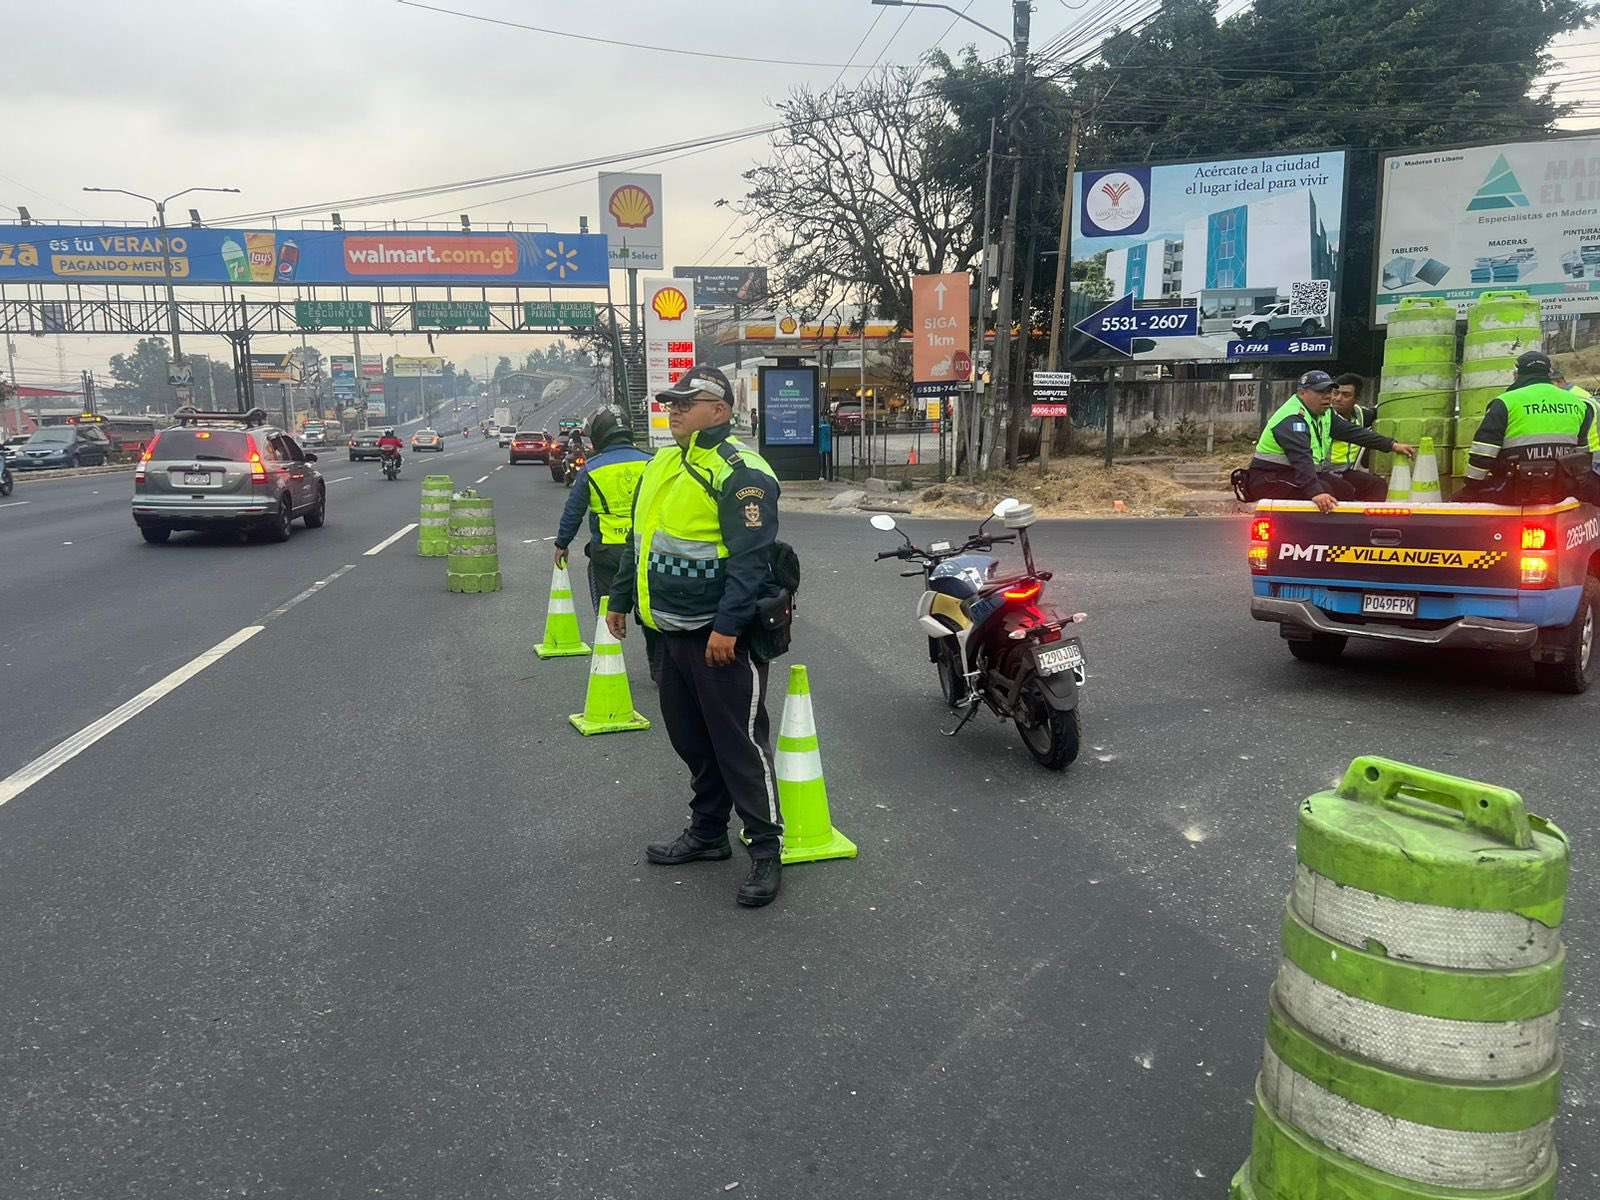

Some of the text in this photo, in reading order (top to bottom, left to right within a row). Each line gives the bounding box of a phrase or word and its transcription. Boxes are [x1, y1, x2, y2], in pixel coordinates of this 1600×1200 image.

[1195, 156, 1320, 178] Acércate a la ciudad
[1185, 174, 1329, 197] el lugar ideal para vivir
[1478, 213, 1543, 225] Especialistas
[1561, 208, 1598, 217] Madera
[49, 237, 187, 253] es tu VERANO
[1488, 238, 1528, 247] MADERAS
[349, 244, 513, 268] walmart.com.gt
[632, 251, 657, 260] Select
[1391, 246, 1429, 255] TABLEROS
[59, 260, 182, 273] PAGANDO MENOS
[924, 317, 957, 329] SIGA
[1102, 317, 1138, 331] 5531
[1149, 315, 1188, 330] 2607
[927, 333, 954, 347] 1km
[1301, 343, 1326, 352] Bam
[1246, 344, 1269, 352] FHA
[1523, 399, 1579, 415] TRÁNSITO
[1526, 446, 1553, 461] VILLA
[1279, 544, 1463, 566] PMT VILLA NUEVA
[1364, 594, 1414, 613] P049FPK
